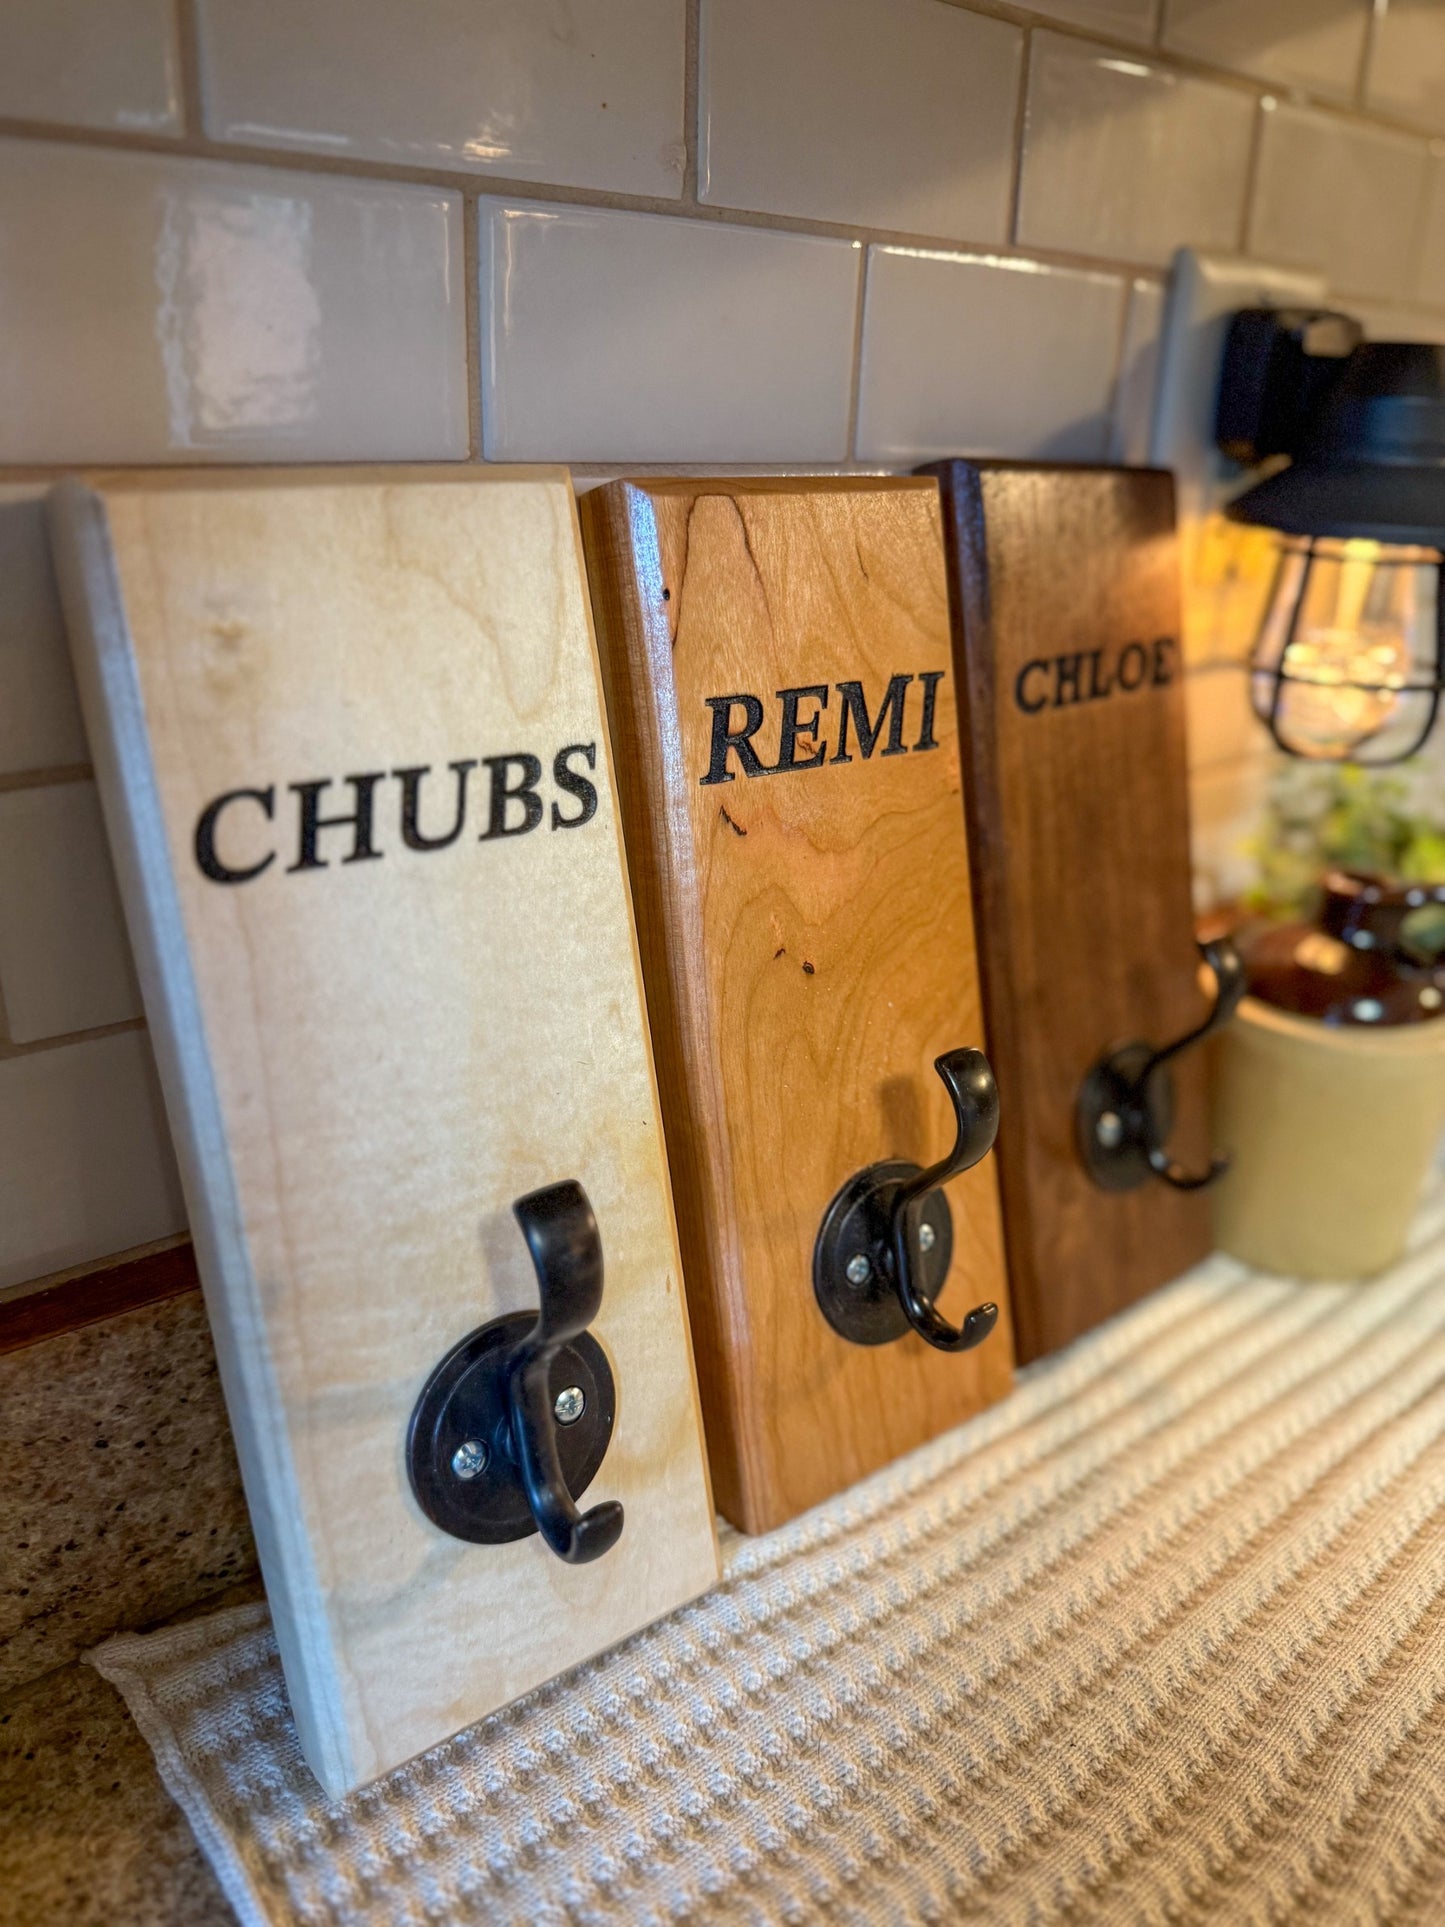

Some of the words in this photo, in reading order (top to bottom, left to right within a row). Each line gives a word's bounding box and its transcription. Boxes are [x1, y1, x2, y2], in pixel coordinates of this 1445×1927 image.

[699, 670, 946, 786] REMI
[1014, 637, 1177, 714] CHLOE
[193, 742, 599, 885] CHUBS
